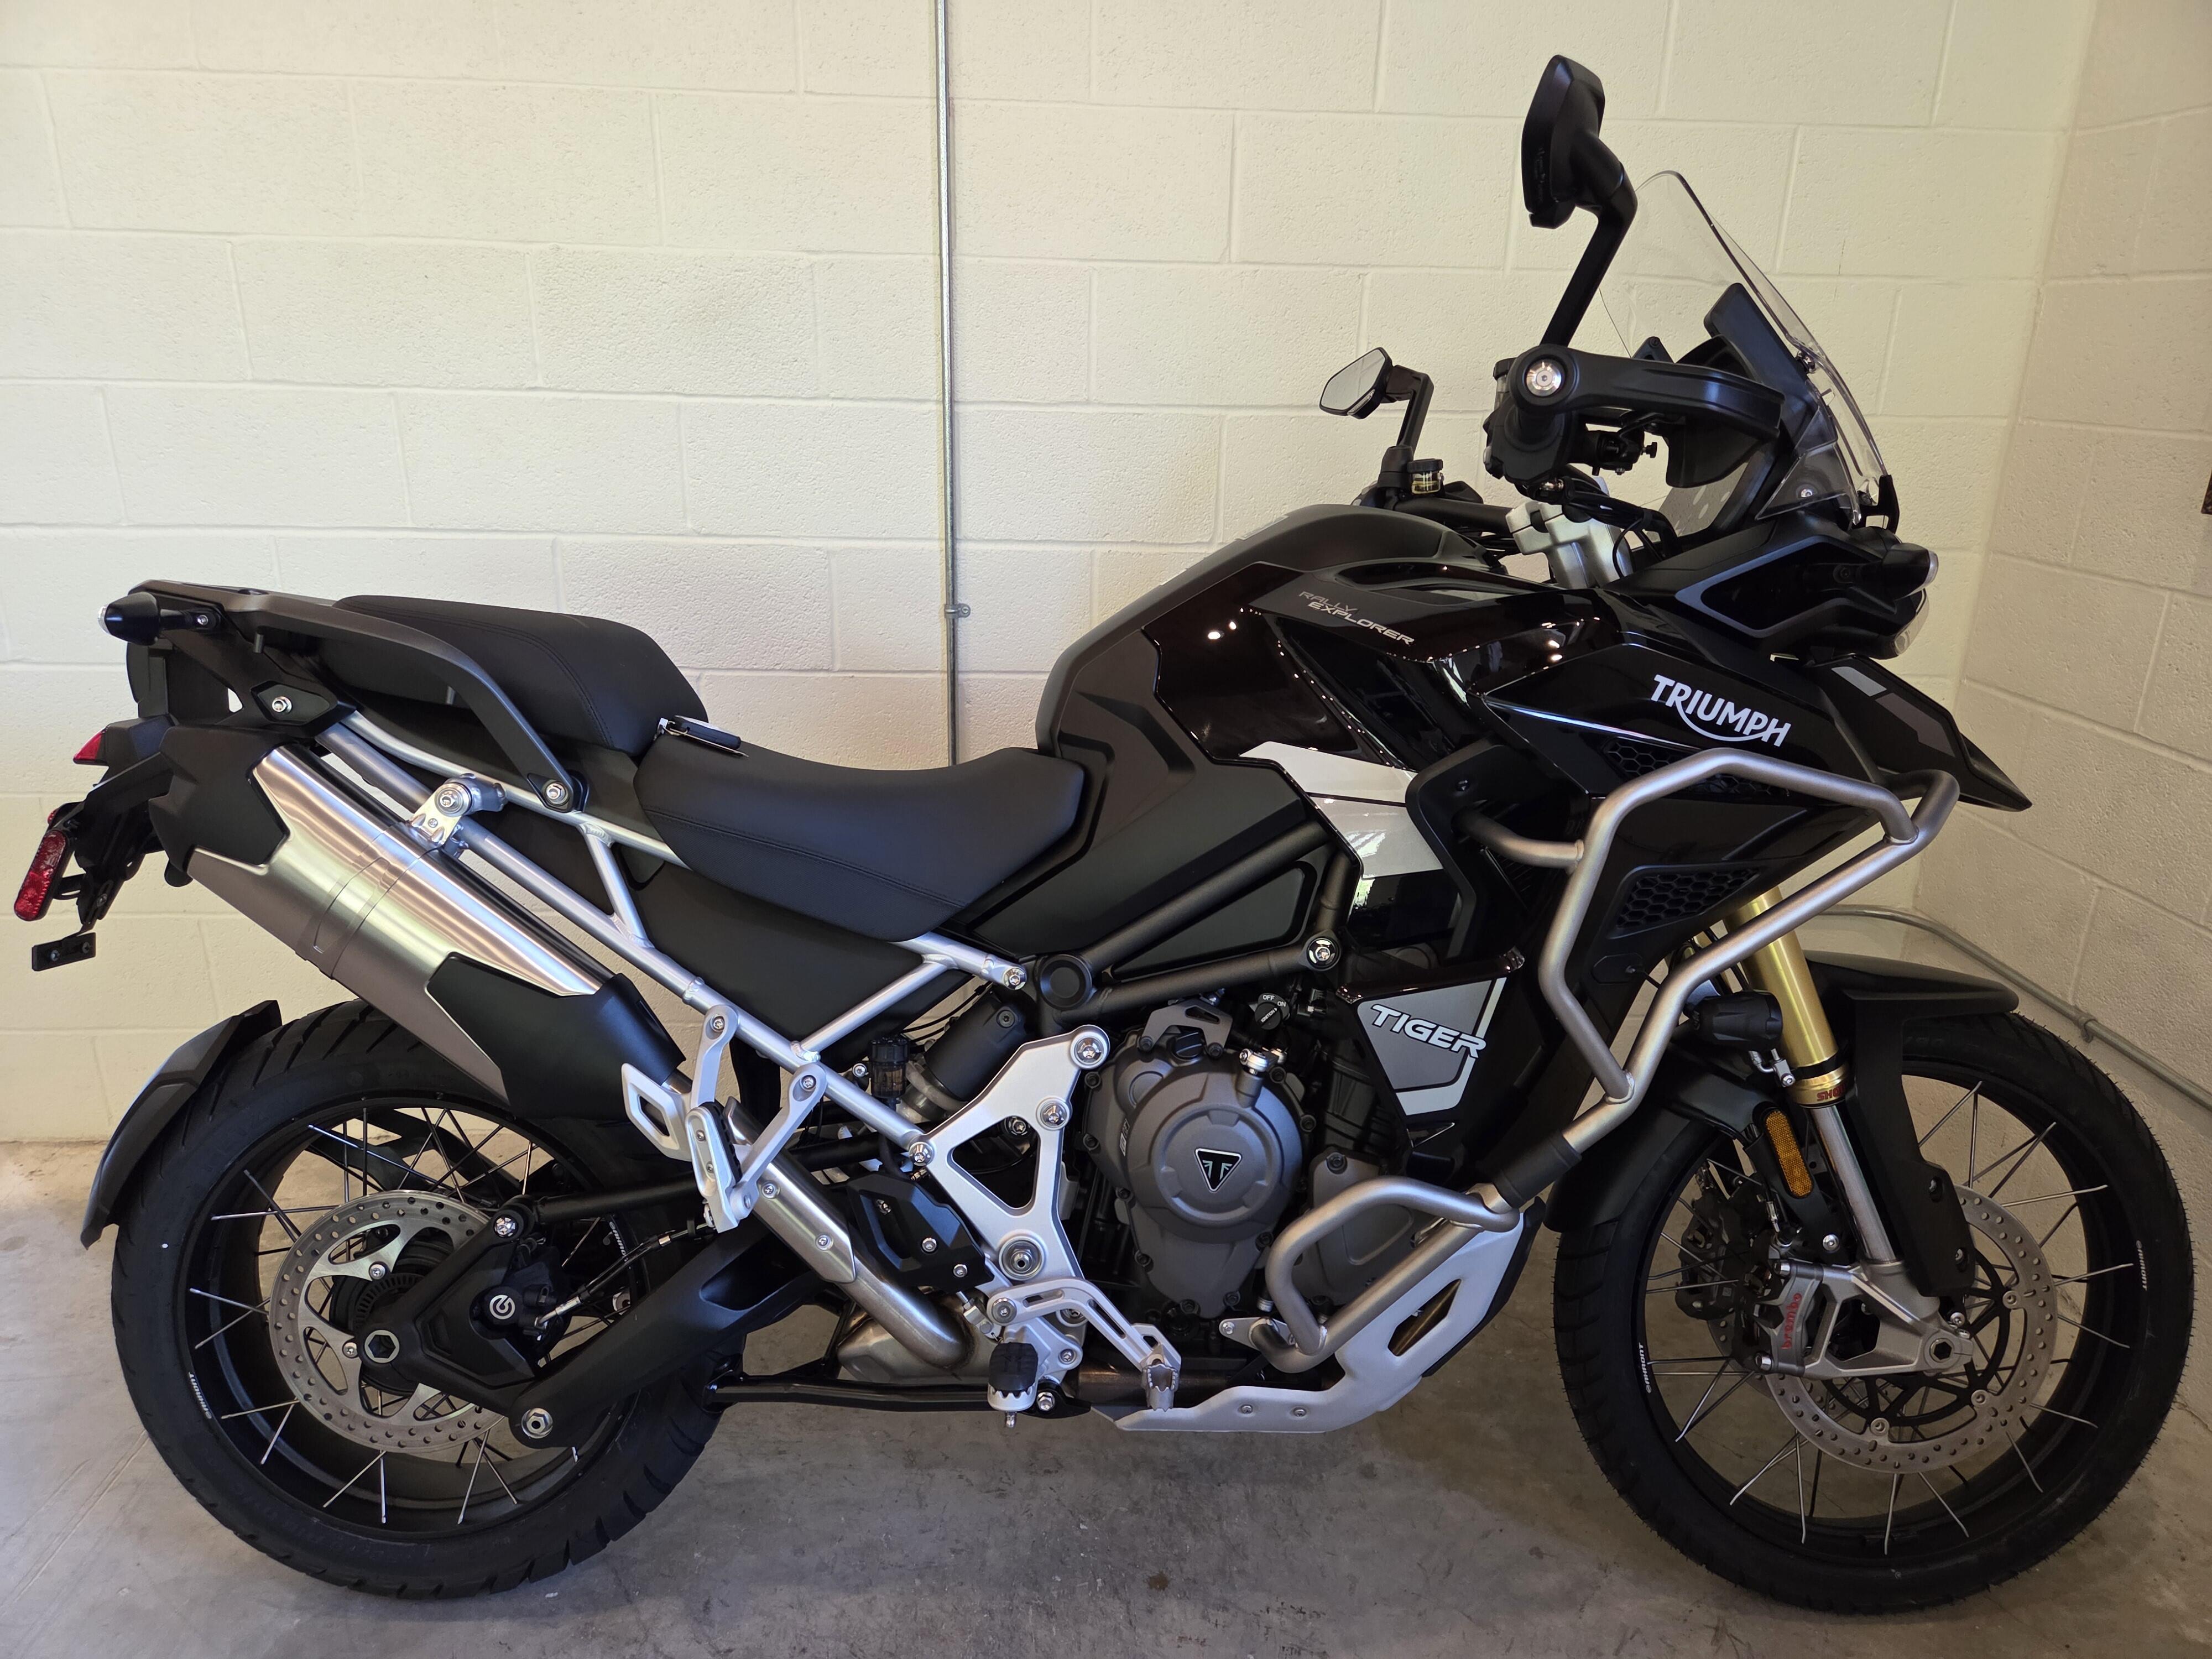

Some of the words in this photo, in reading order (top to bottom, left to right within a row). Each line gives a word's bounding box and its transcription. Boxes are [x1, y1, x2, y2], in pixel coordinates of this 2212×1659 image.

[1298, 591, 1358, 613] RALLY
[1308, 601, 1415, 645] EXPLORER
[1650, 674, 1792, 747] TRIUMPH
[1260, 1009, 1276, 1022] IGNITION
[1371, 1004, 1487, 1058] TIGER
[1781, 1292, 1803, 1350] brembo
